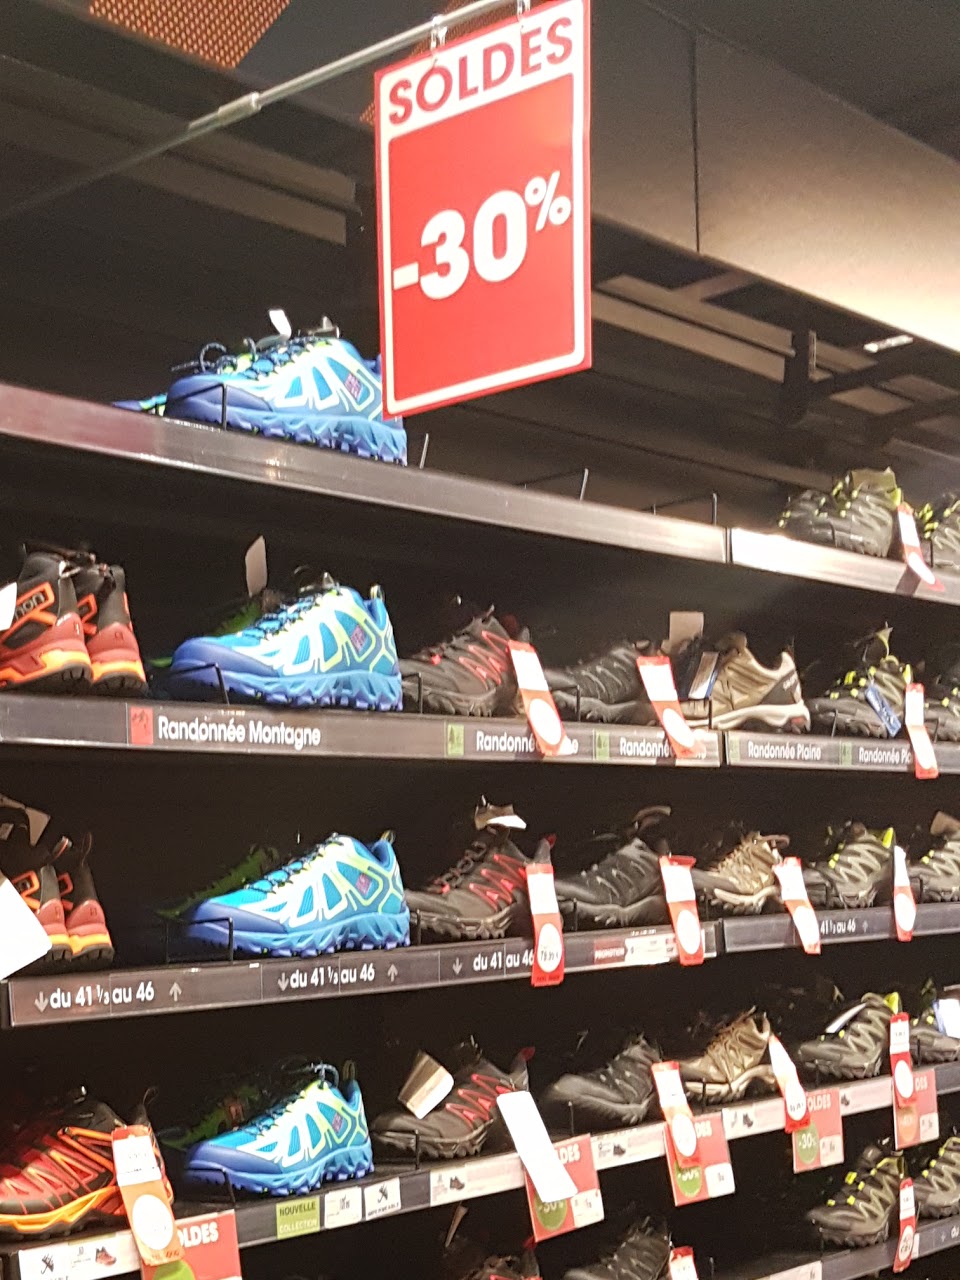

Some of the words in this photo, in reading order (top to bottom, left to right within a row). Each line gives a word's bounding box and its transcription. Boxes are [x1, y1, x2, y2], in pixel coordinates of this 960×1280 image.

[388, 16, 573, 126] SOLDES
[392, 170, 572, 300] -30%
[158, 714, 246, 742] Randonnée
[248, 720, 321, 751] Montagne
[476, 731, 538, 753] Randonné
[619, 737, 674, 758] Randonné
[473, 956, 488, 972] du
[490, 954, 502, 969] 41
[506, 954, 520, 968] au
[290, 970, 308, 988] du
[310, 967, 325, 986] 41
[340, 968, 358, 984] au
[360, 963, 376, 982] 46
[50, 987, 72, 1009] du
[75, 986, 93, 1006] 41
[113, 985, 133, 1004] au
[136, 980, 155, 1001] 46
[807, 1094, 831, 1111] OLDES
[279, 1201, 316, 1217] NOUVELLE
[279, 1218, 317, 1235] COLLECTION
